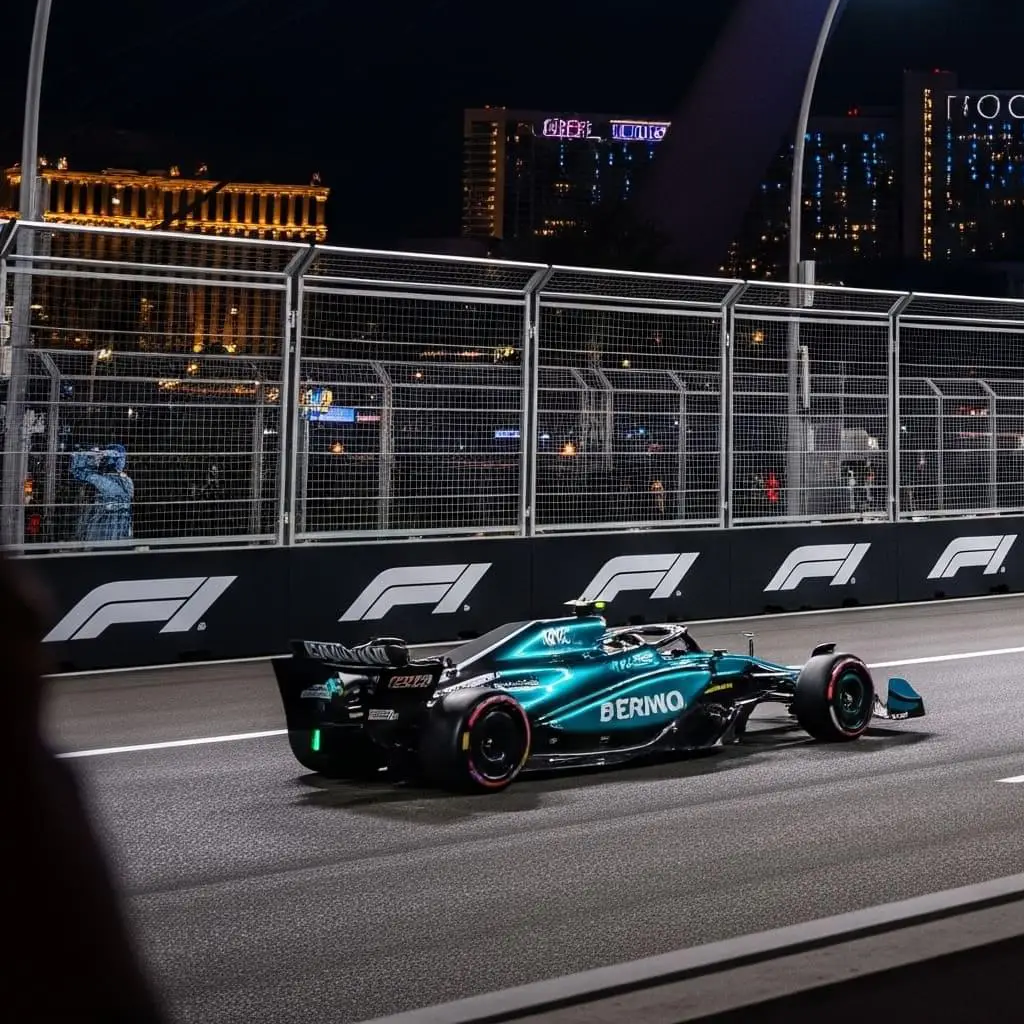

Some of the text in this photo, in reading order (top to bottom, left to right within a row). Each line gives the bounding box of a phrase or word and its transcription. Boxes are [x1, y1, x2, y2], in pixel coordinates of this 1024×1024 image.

[578, 552, 699, 602] F1
[764, 543, 871, 591] F1
[927, 535, 1017, 579] F1
[43, 576, 237, 641] F1
[339, 563, 492, 621] F1
